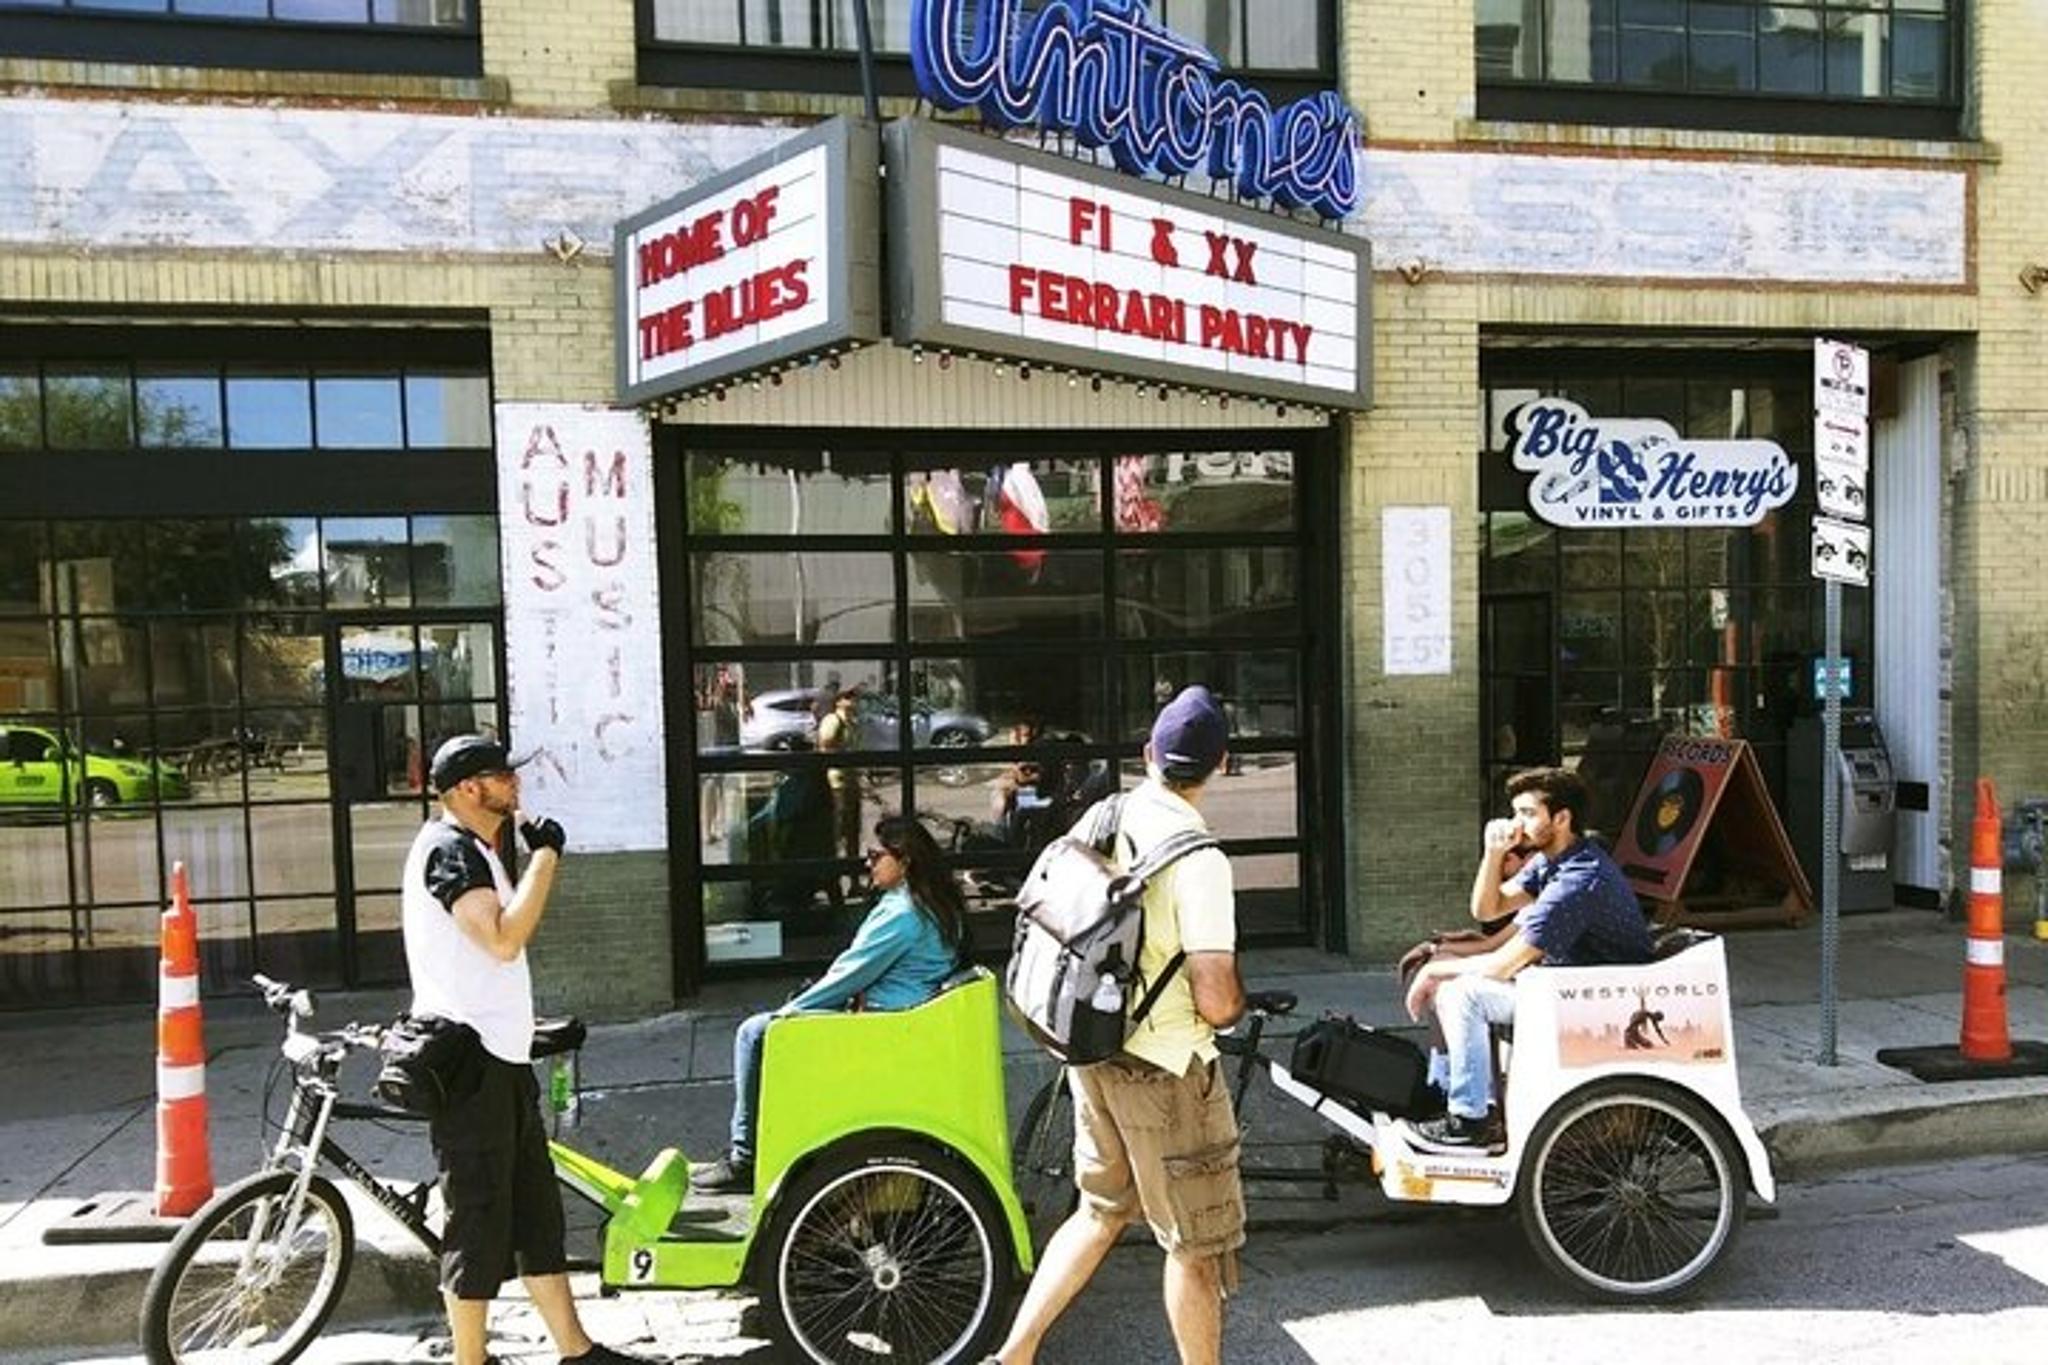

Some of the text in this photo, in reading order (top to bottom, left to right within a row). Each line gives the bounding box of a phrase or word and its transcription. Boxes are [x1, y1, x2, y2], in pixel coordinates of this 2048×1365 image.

[638, 184, 780, 289] HOME OF
[1206, 229, 1258, 285] XX
[638, 258, 809, 360] THE BLUES
[1009, 264, 1313, 366] FERRARI PARTY
[1522, 405, 1788, 516] Big Henry's
[1575, 506, 1738, 520] VINYL & GIFTS
[1558, 982, 1719, 999] WESTWORLD
[633, 1249, 653, 1280] 9
